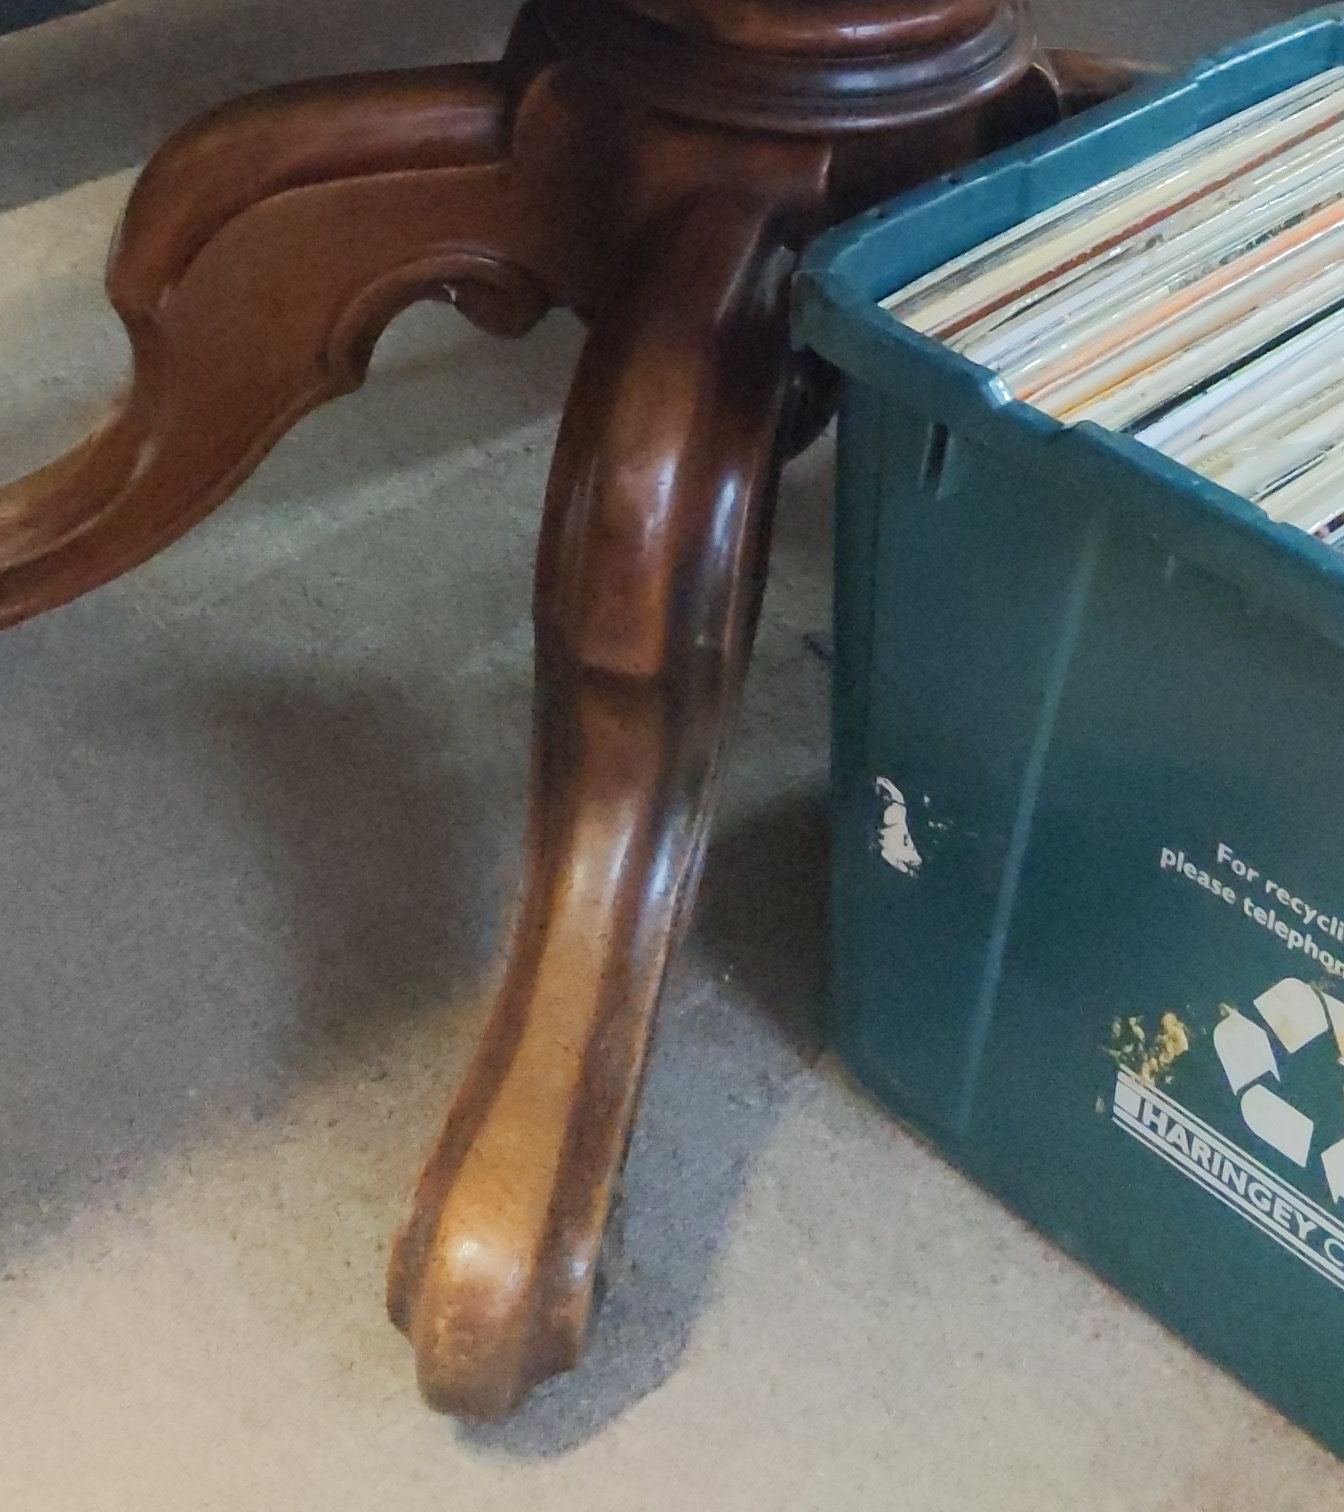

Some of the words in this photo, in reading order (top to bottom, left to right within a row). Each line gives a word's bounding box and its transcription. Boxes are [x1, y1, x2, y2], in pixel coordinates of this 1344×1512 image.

[1160, 847, 1236, 904] please
[1217, 842, 1260, 882] For
[1142, 1099, 1318, 1241] HARINGEY
